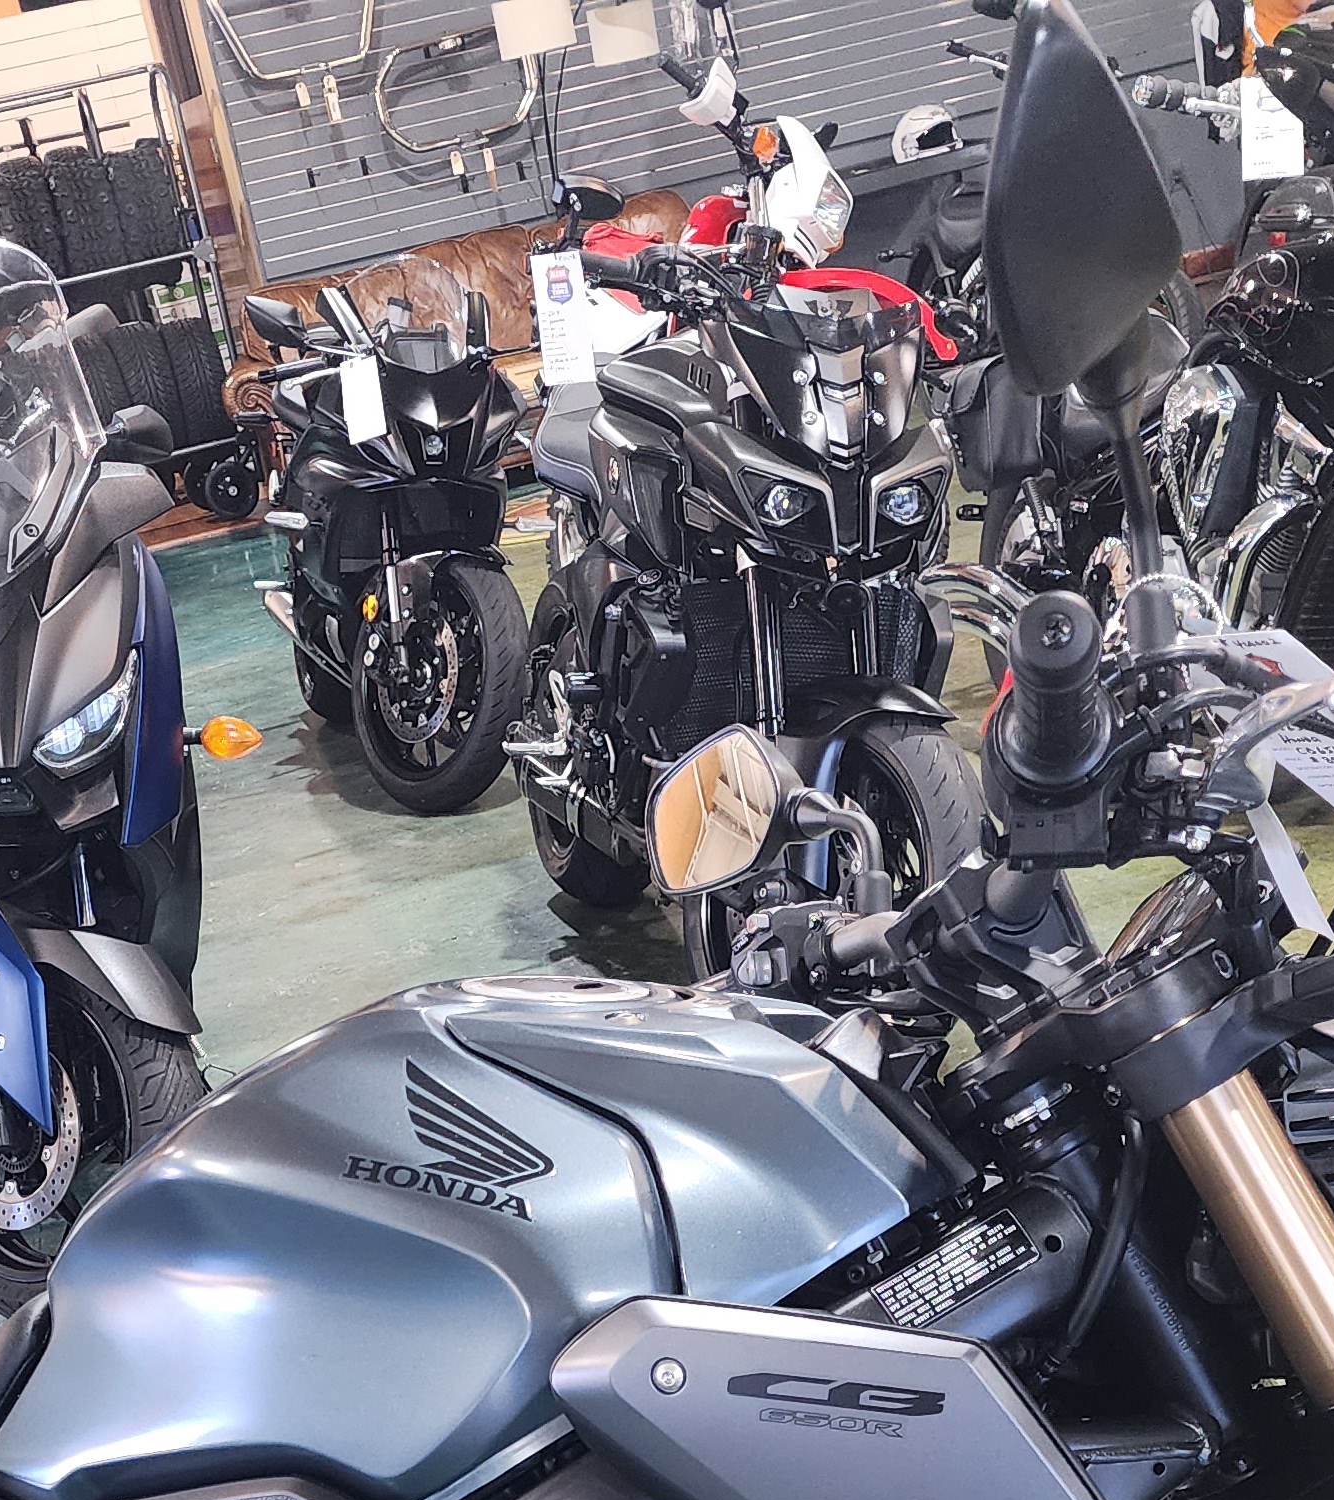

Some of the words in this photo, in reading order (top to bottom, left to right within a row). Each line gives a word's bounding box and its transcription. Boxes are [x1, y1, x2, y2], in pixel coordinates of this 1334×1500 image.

[342, 1155, 533, 1222] HONDA
[727, 1372, 946, 1417] CB
[759, 1407, 903, 1439] 650R
